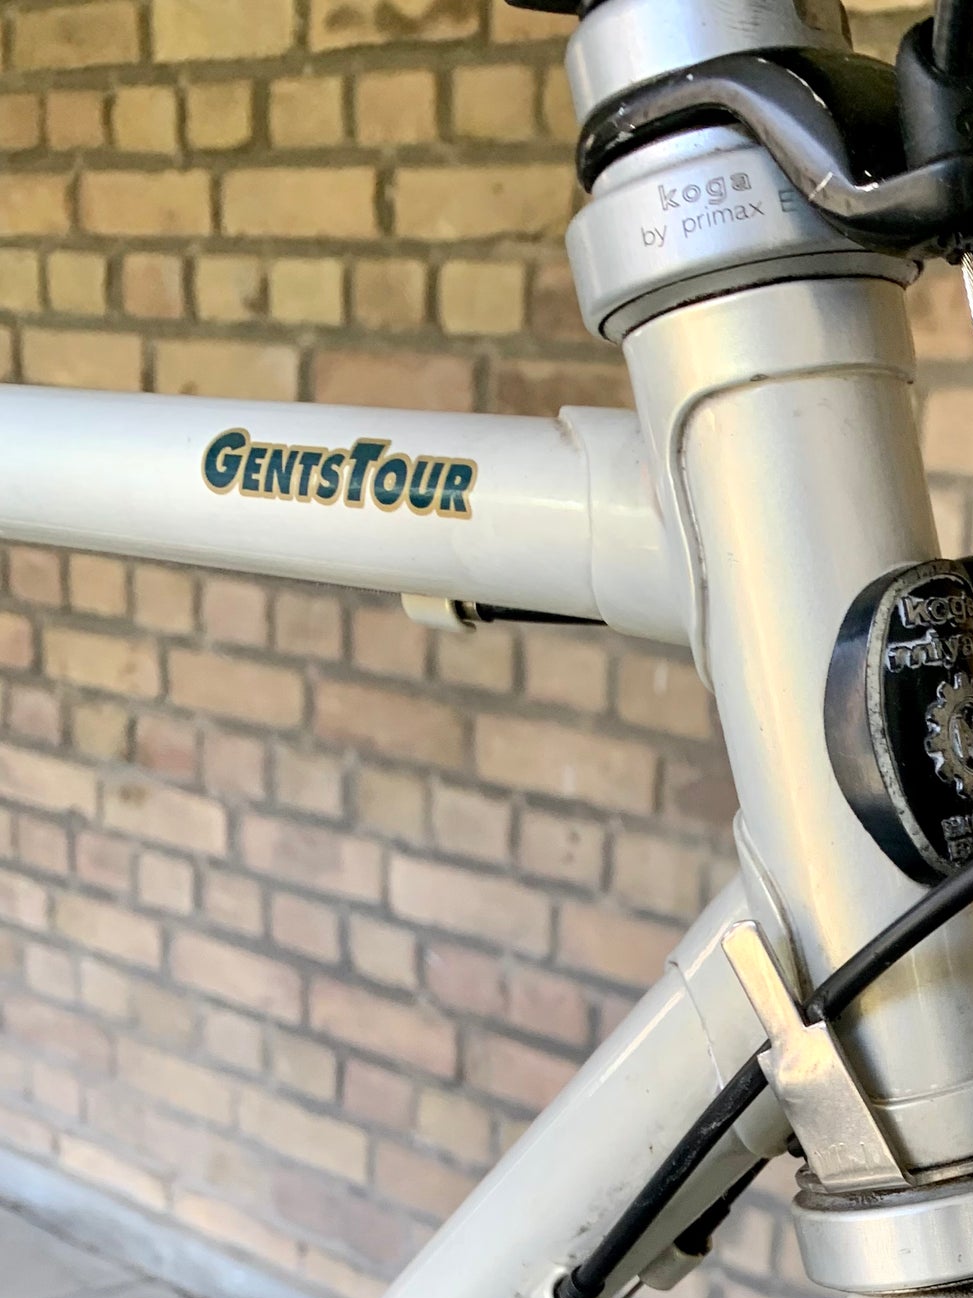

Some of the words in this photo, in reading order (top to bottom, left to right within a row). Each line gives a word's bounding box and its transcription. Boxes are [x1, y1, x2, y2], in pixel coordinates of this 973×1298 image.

[658, 172, 752, 211] koga
[641, 224, 669, 248] by
[682, 201, 766, 238] primax
